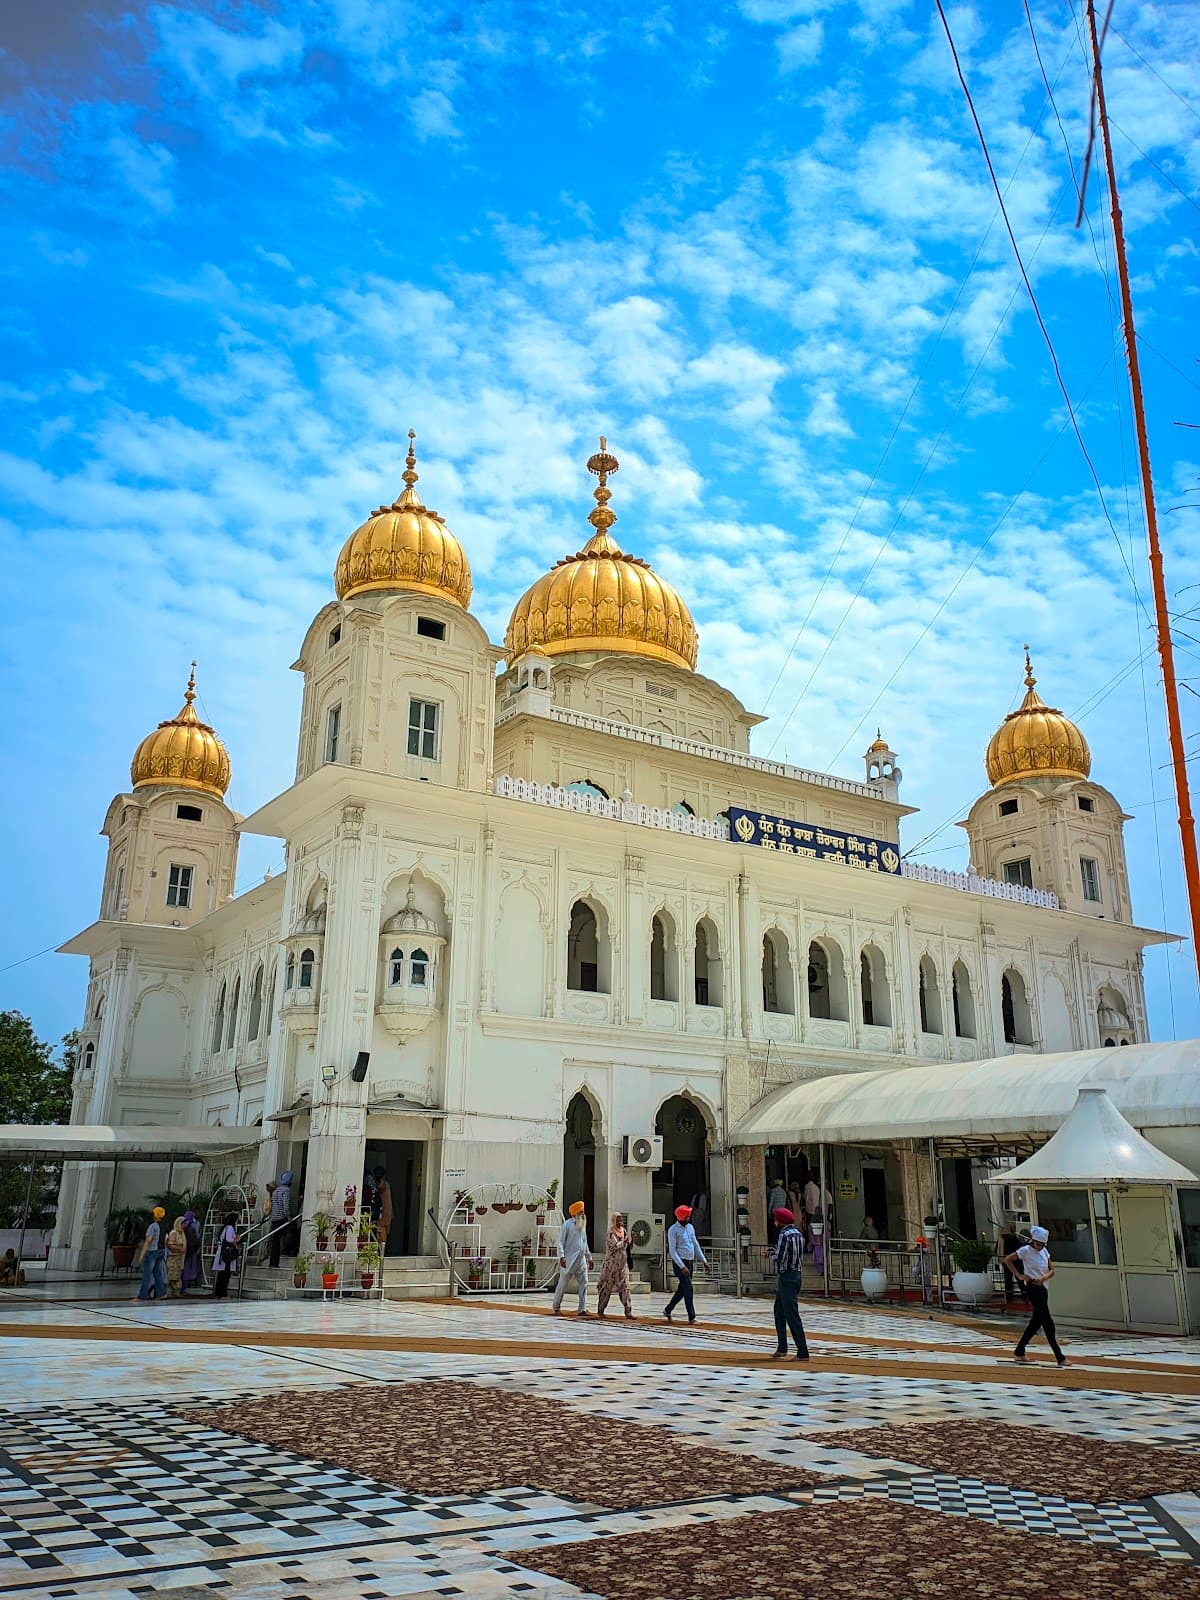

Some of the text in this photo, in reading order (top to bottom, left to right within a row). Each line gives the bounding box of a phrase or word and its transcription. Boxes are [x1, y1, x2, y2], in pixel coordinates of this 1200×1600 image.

[793, 828, 814, 842] ਬਾਬਾ
[847, 836, 865, 854] ਸਿੰਘ
[866, 841, 878, 856] ਜੀ
